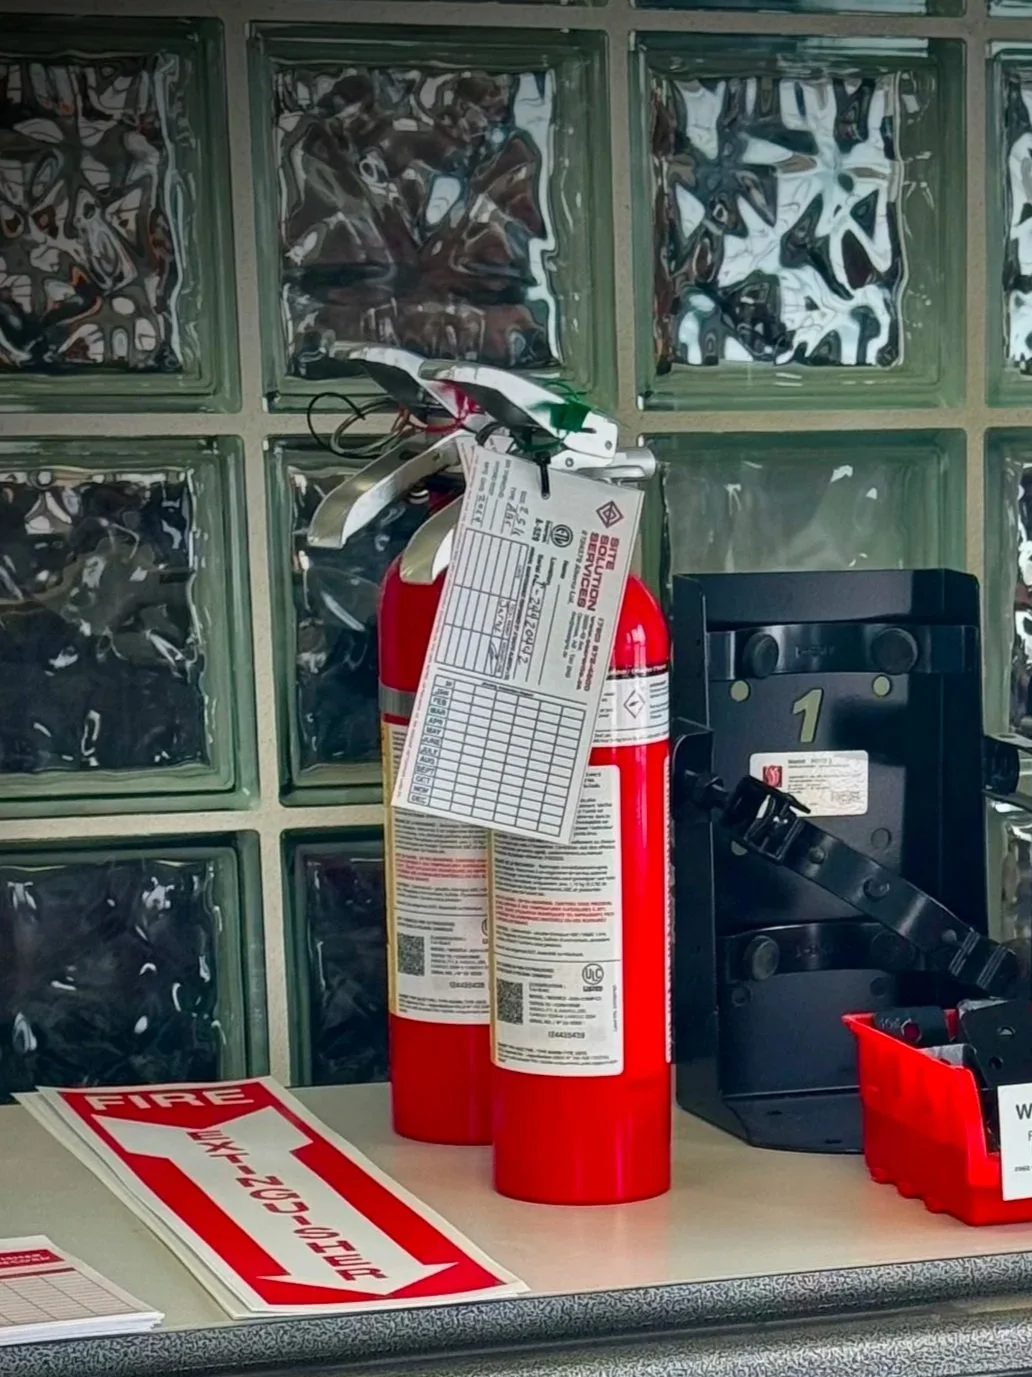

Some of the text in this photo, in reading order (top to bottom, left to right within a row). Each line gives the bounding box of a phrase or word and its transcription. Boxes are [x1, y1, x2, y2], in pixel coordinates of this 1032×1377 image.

[577, 531, 600, 610] SERVICES
[587, 534, 611, 612] SOLUTION
[604, 537, 620, 571] SITE
[792, 688, 824, 744] 1
[84, 1087, 255, 1111] FIRE
[186, 1128, 389, 1282] EXTINGUISHER
